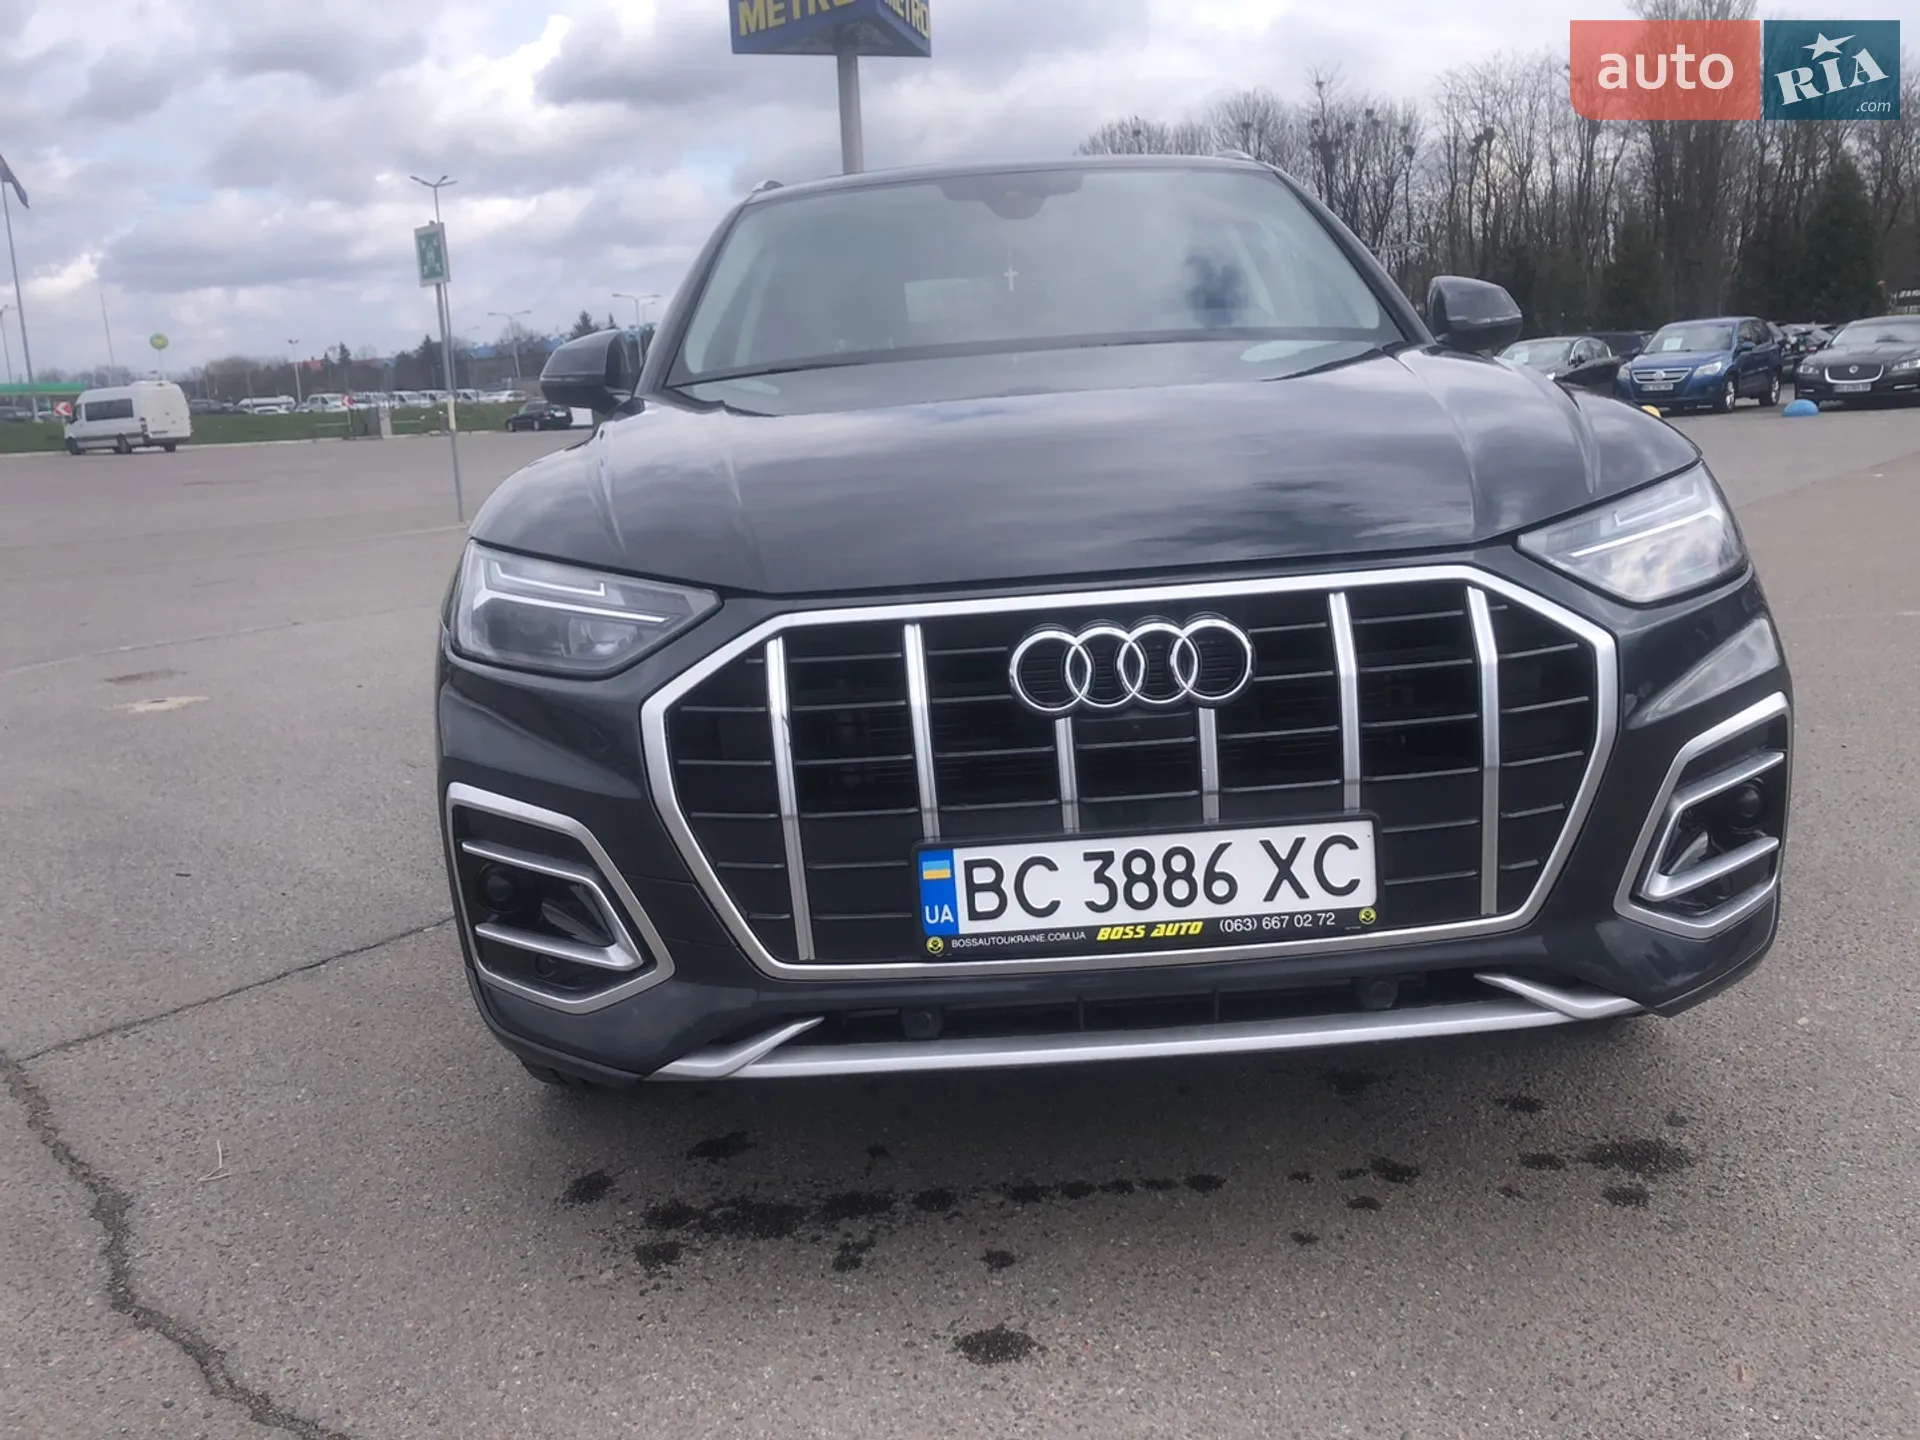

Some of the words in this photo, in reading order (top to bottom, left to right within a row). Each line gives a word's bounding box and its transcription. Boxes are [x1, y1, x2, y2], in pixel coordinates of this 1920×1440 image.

[962, 855, 1061, 921] BC
[1083, 841, 1238, 913] 3886
[1258, 834, 1361, 902] XC
[925, 904, 954, 924] UA
[951, 931, 1087, 948] BOSSAUTOUKRAINE.COM.UA
[1096, 924, 1146, 941] BOSS
[1150, 921, 1204, 938] AUTO
[1219, 917, 1258, 933] (063)
[1262, 915, 1289, 930] 667
[1294, 914, 1313, 928] 02
[1317, 912, 1336, 926] 72
